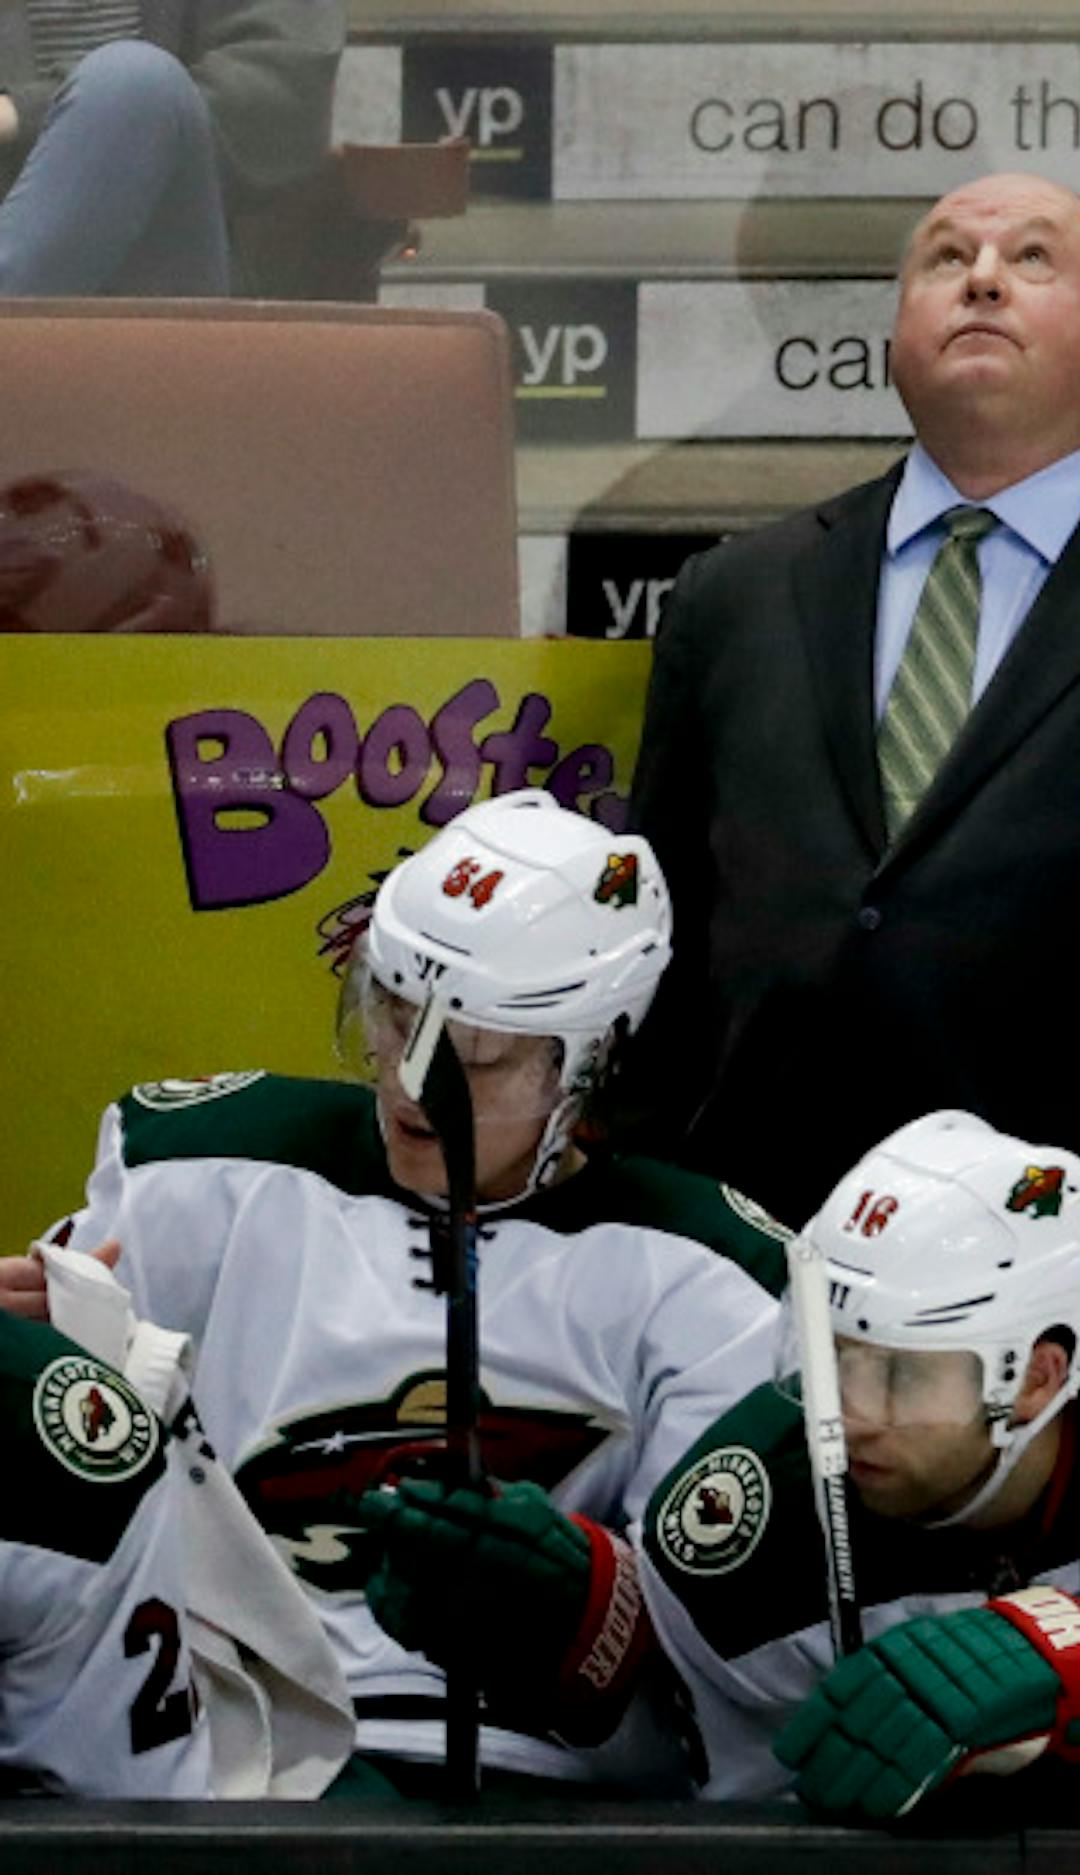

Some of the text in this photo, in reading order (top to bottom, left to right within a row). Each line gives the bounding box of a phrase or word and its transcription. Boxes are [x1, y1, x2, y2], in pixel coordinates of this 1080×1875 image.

[437, 85, 523, 142] yp
[689, 97, 841, 154] can
[876, 80, 979, 153] do
[520, 323, 607, 385] yp
[773, 335, 892, 391] ca
[841, 1190, 899, 1239] 16
[122, 1596, 200, 1756] 2
